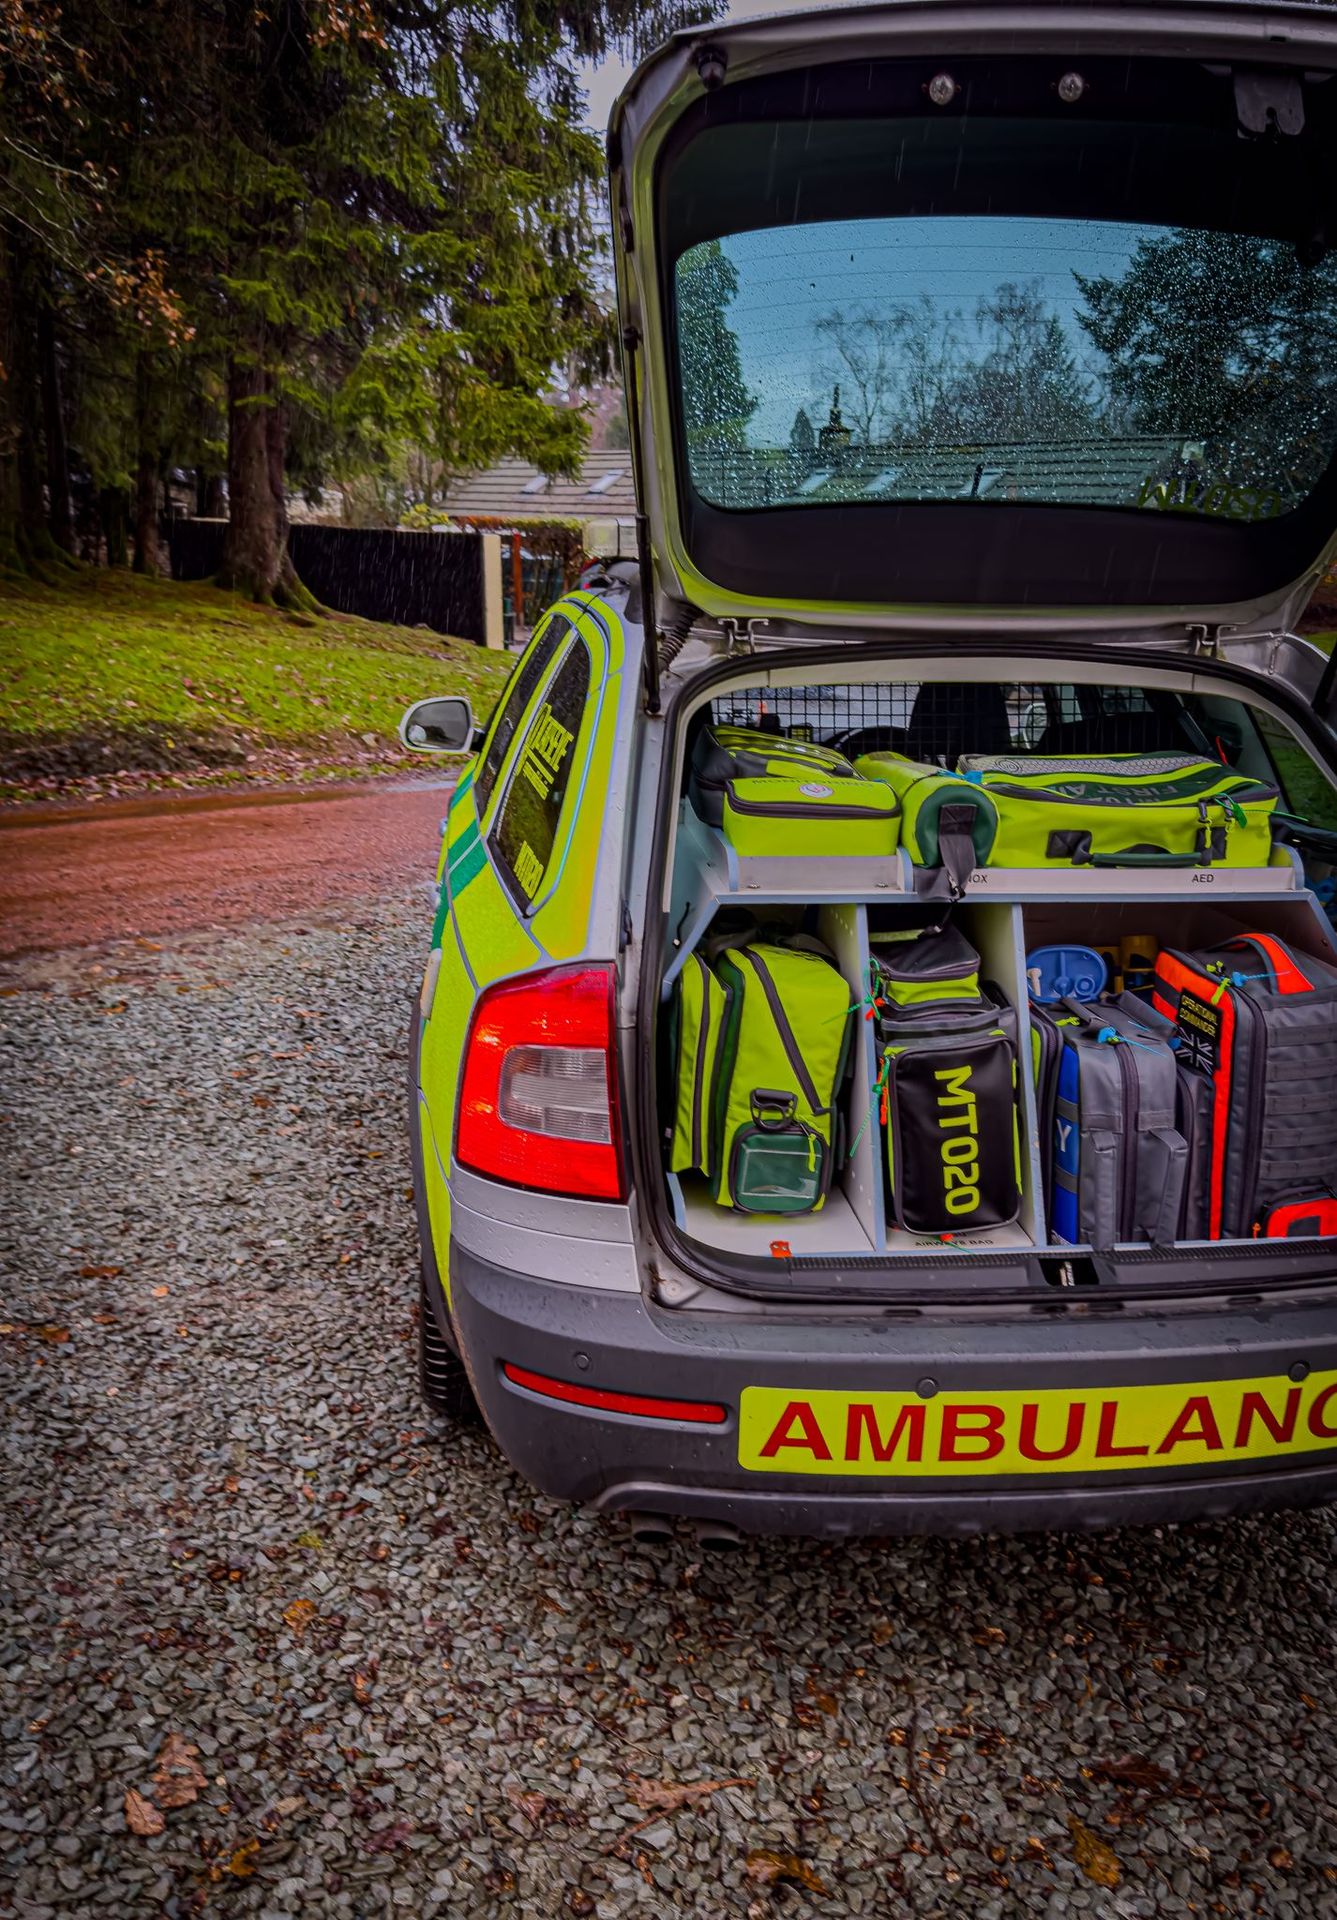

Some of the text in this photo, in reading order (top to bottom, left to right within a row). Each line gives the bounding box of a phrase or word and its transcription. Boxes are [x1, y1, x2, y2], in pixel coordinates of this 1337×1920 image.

[1097, 784, 1178, 797] FIRST
[1191, 873, 1215, 883] AED
[934, 1065, 980, 1215] MT020
